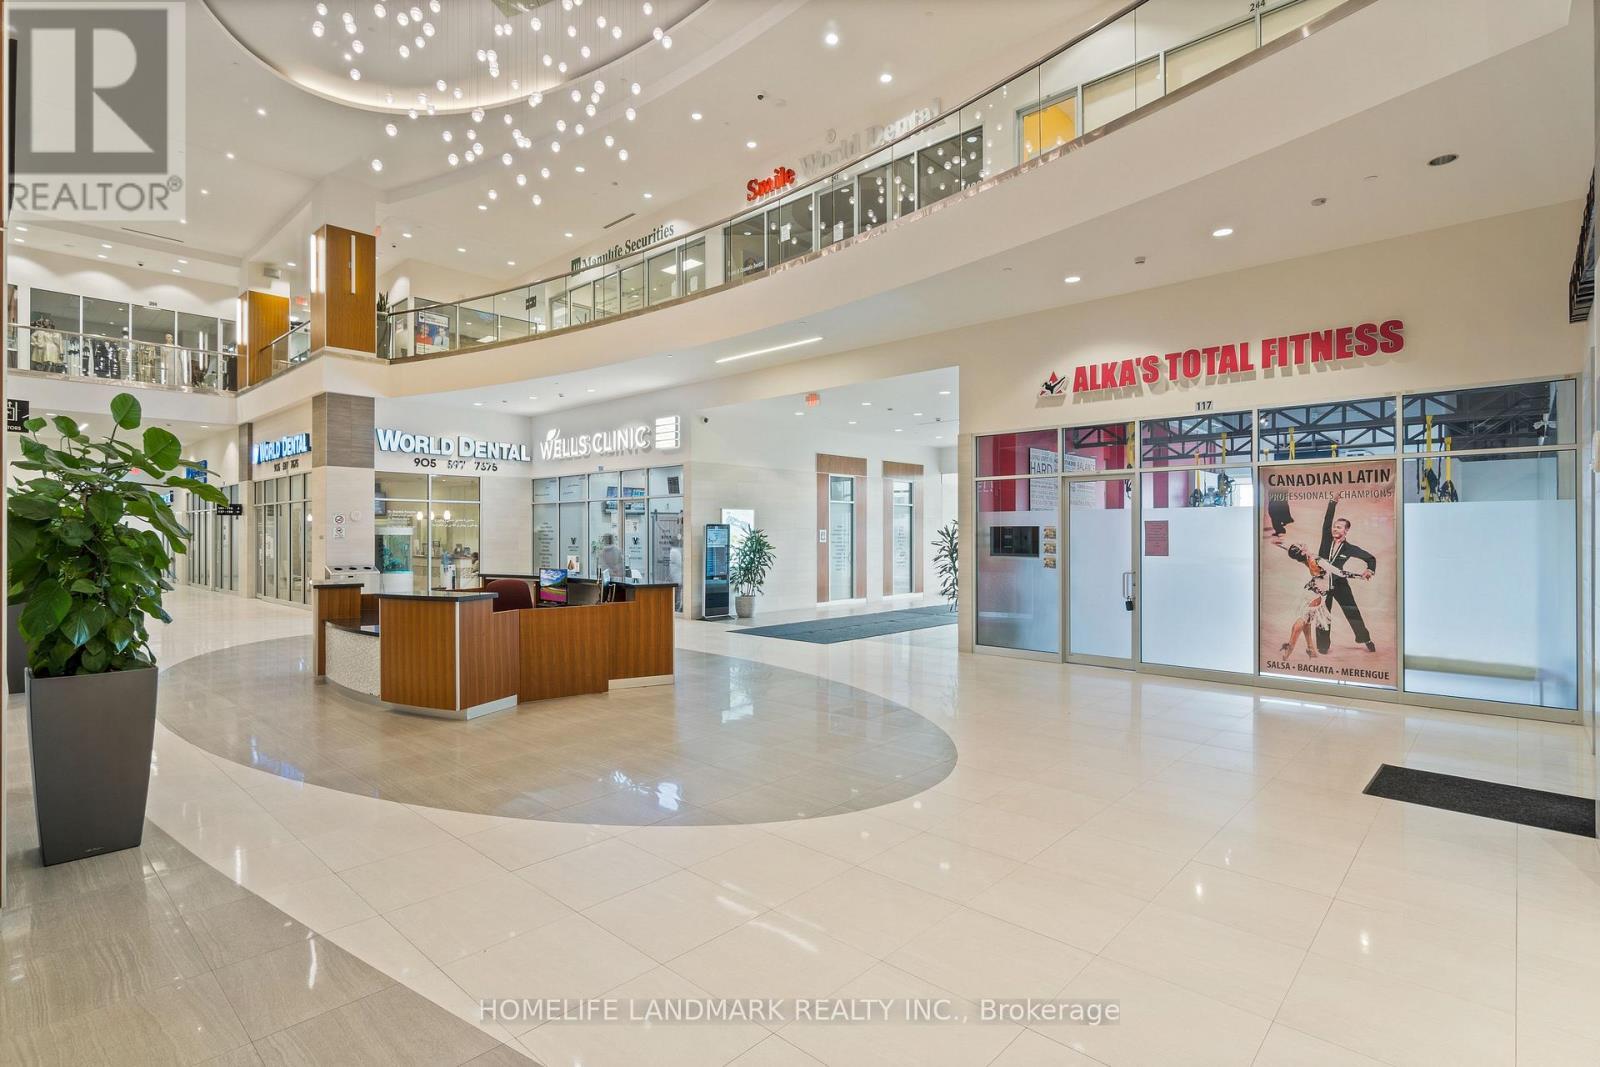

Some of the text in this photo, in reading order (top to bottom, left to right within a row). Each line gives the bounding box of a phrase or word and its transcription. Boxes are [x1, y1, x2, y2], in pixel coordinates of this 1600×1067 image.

[747, 166, 796, 201] Smile
[625, 225, 675, 254] Securities
[1072, 319, 1405, 393] ALKA'S TOTAL FITNESS
[1197, 400, 1212, 411] 117
[376, 428, 532, 462] WORLD DENTAL
[540, 424, 650, 460] WELLS CLINIC
[413, 457, 437, 469] 905
[1268, 468, 1392, 487] CANADIAN LATIN
[1268, 488, 1392, 501] PROFESSIONALS CHAMPIONS
[1266, 660, 1390, 680] SALSA BACHATA MERENGUE
